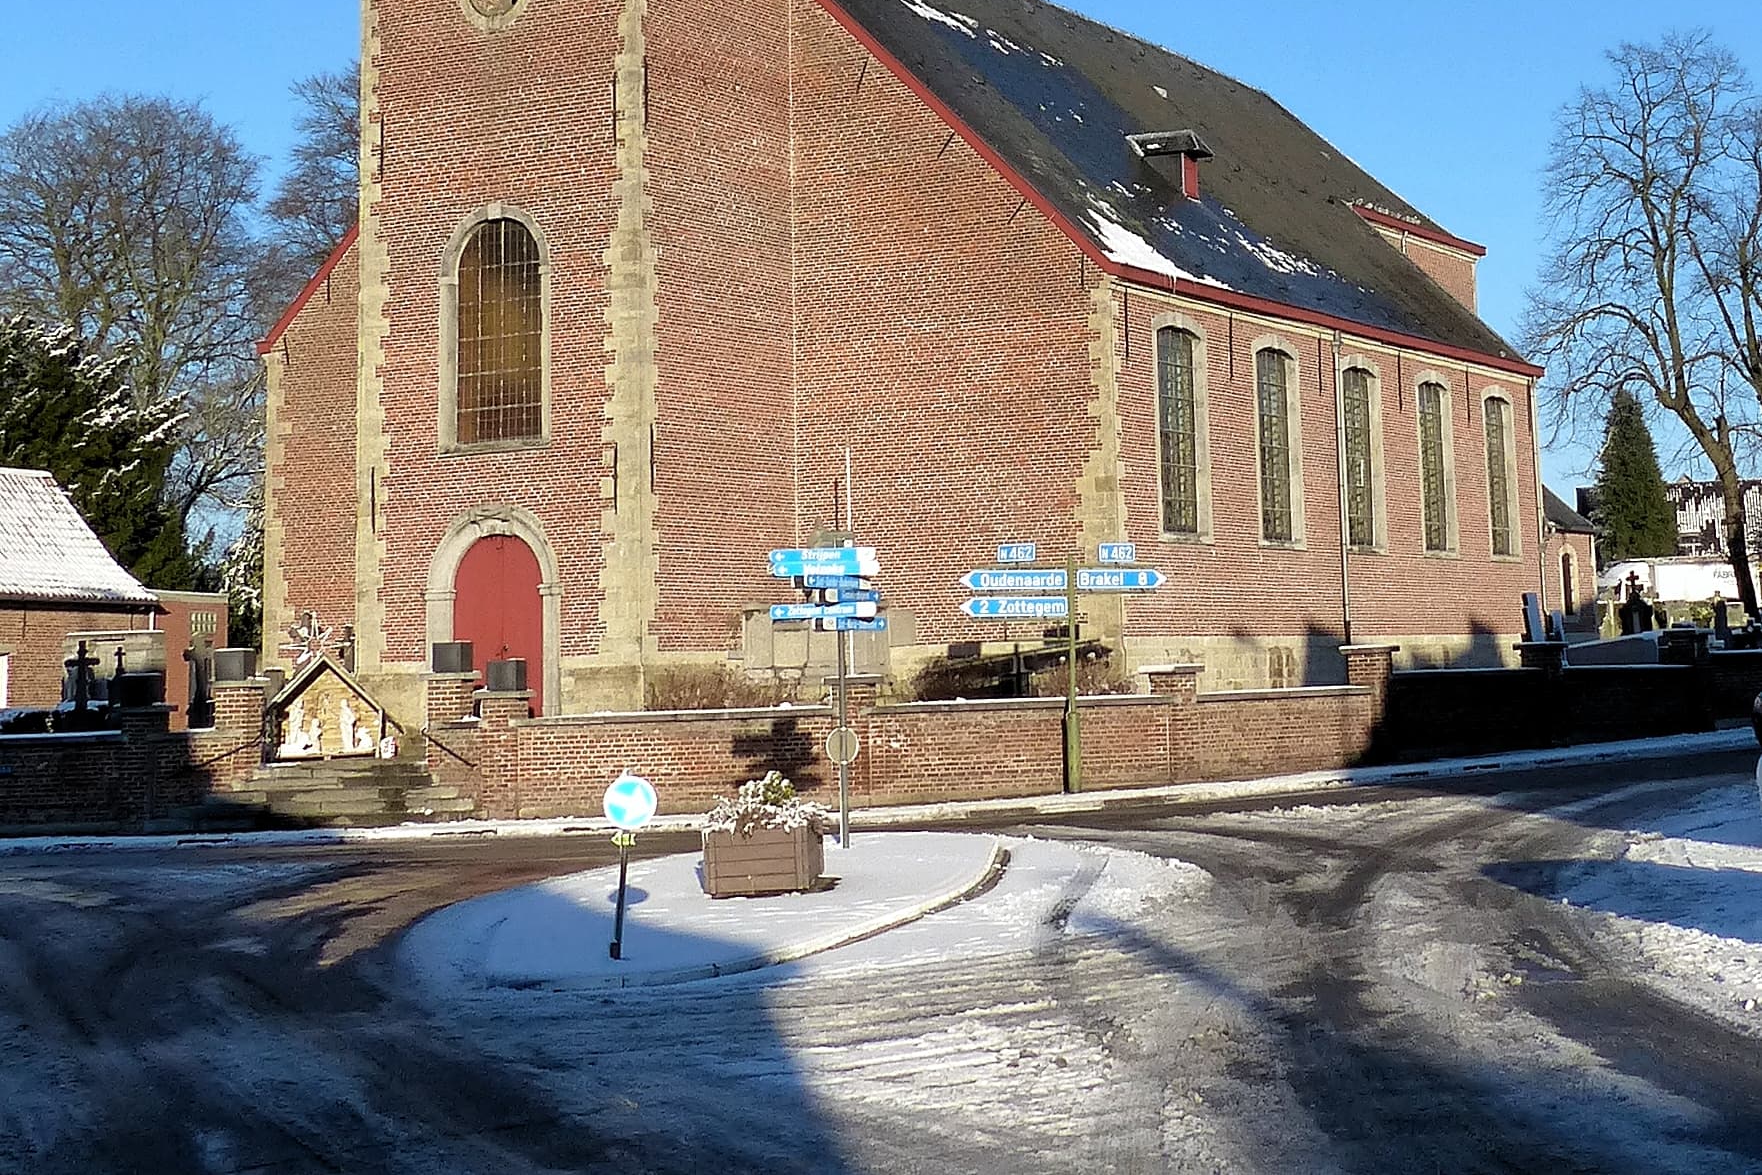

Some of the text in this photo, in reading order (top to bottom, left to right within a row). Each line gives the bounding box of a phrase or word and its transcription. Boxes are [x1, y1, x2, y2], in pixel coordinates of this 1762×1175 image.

[980, 573, 1063, 587] Oudenaarde
[1080, 572, 1124, 586] Brakel
[979, 599, 1065, 617] 2 Zottegem
